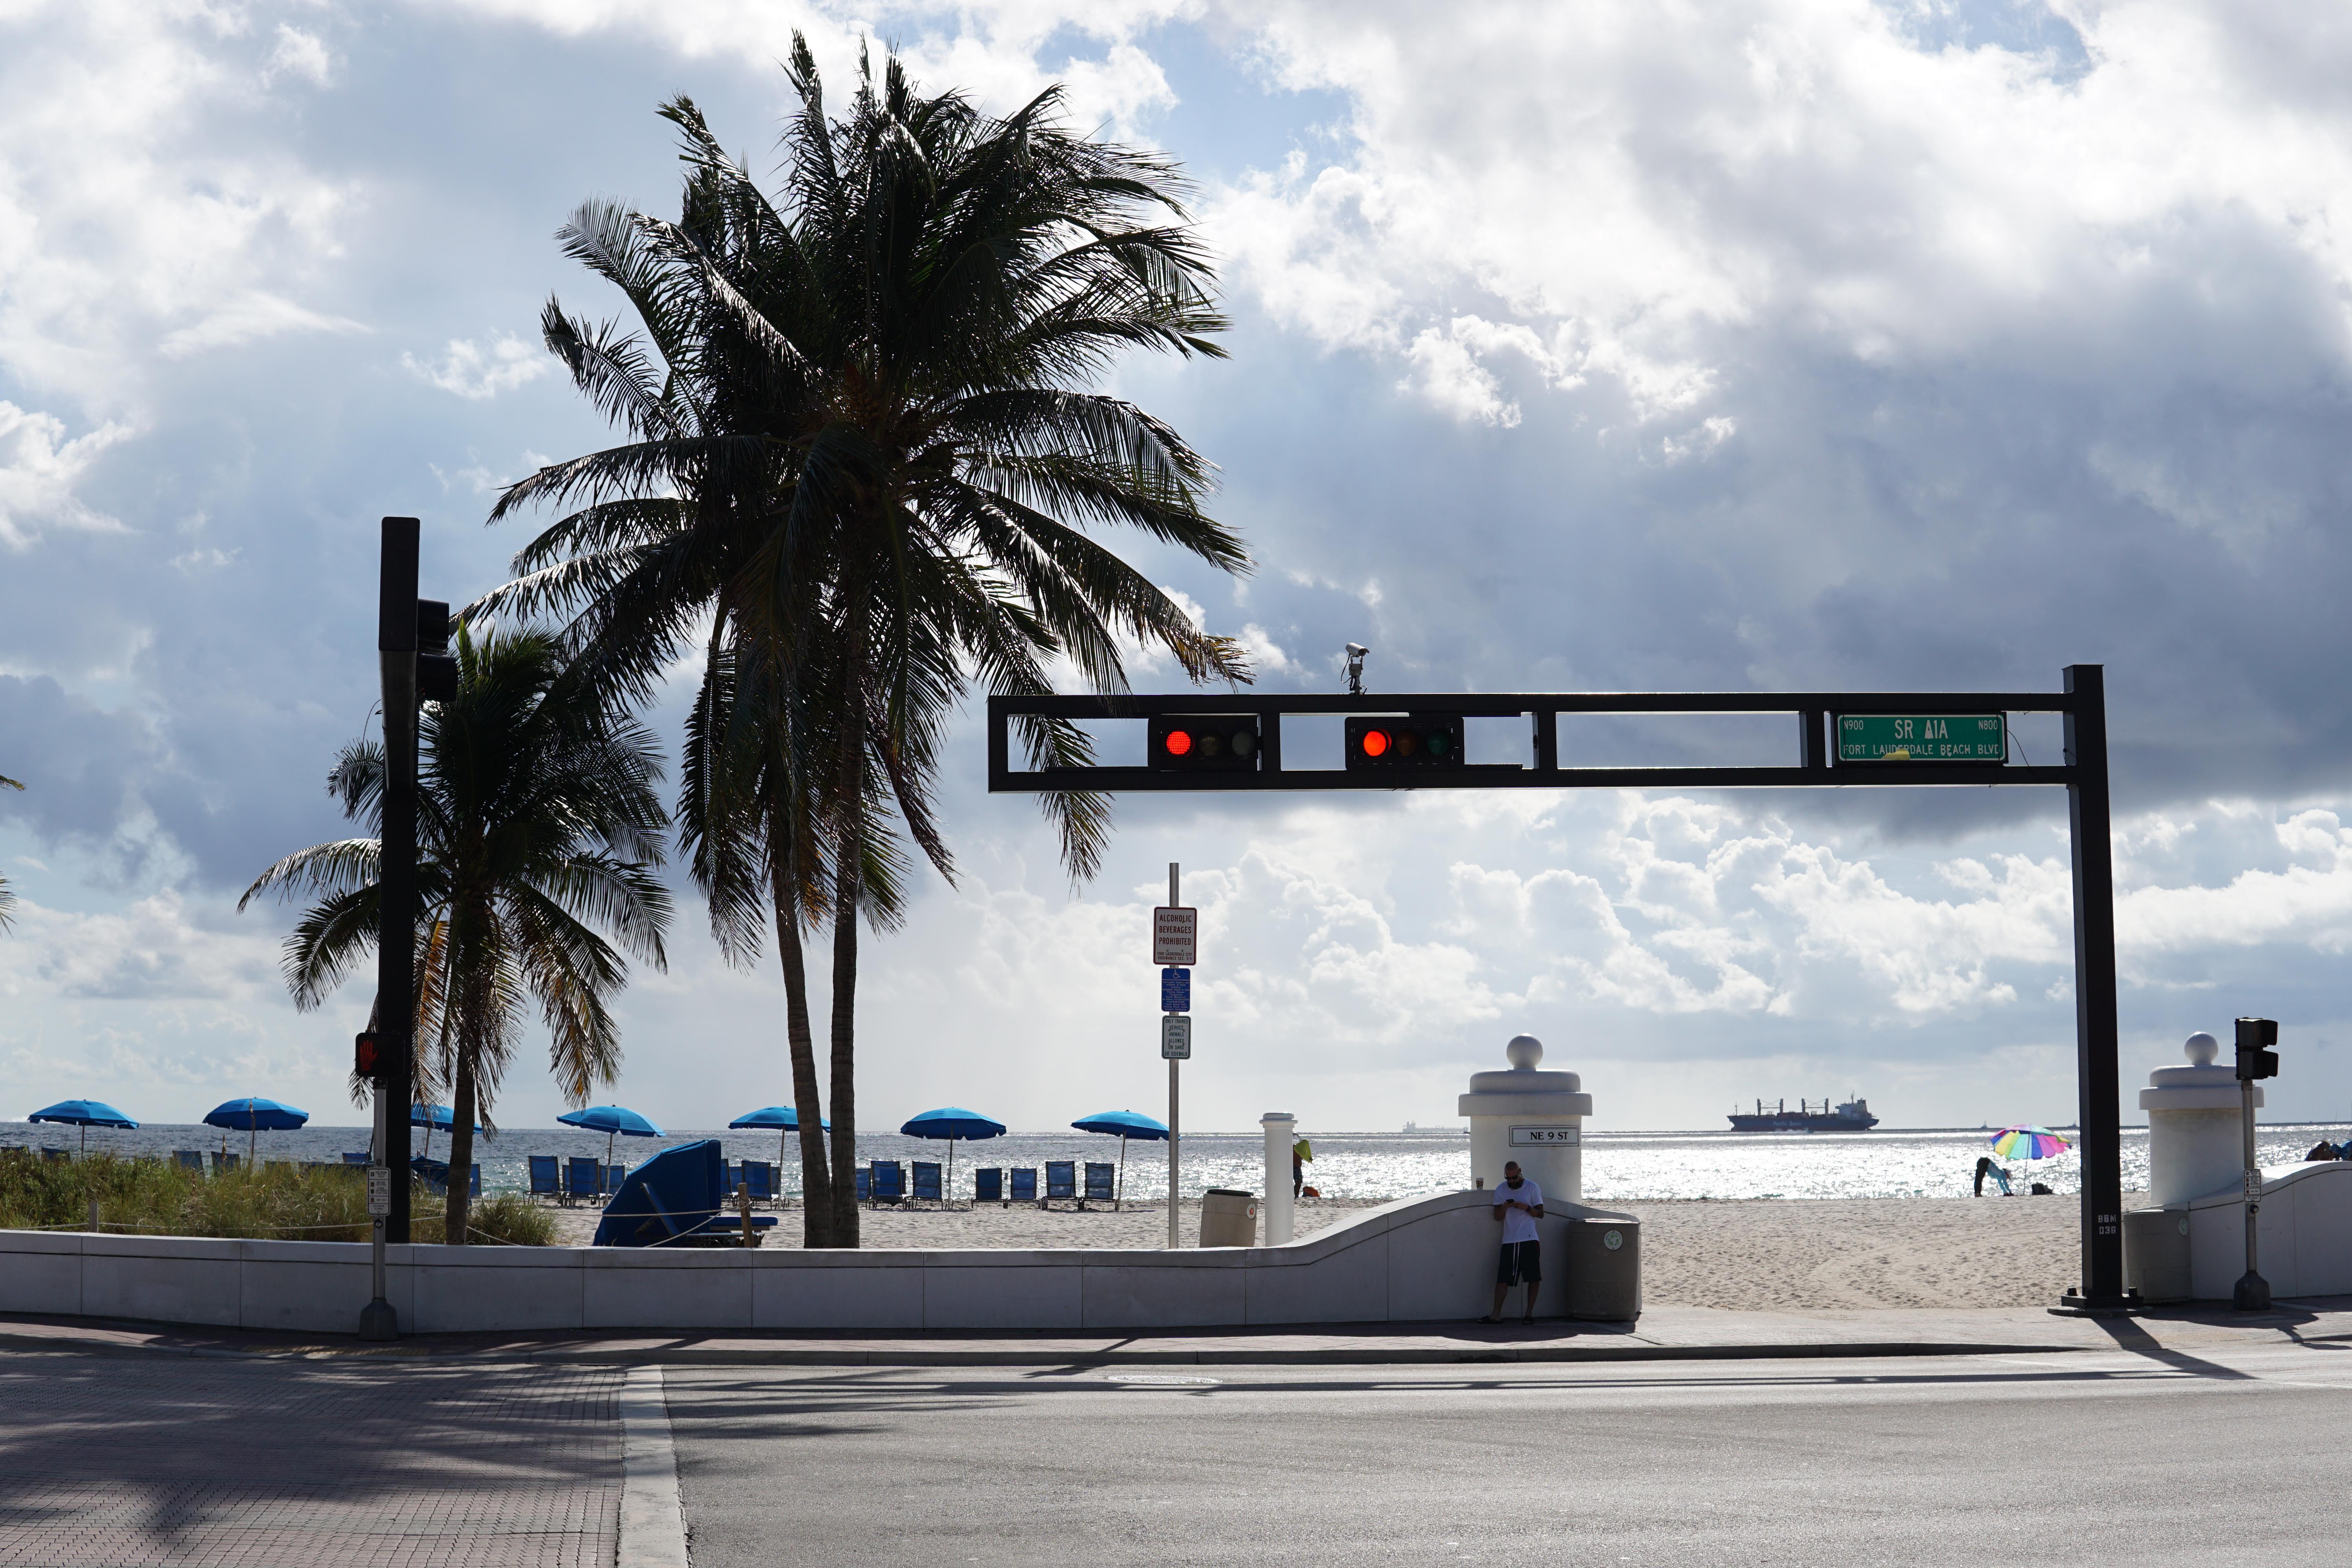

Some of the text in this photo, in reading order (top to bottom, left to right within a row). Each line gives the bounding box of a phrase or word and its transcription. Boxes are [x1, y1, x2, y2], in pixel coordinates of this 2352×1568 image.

[1844, 720, 1864, 730] N900
[1895, 719, 1948, 739] SR A1A
[1978, 720, 1998, 730] N800
[1844, 744, 1866, 755] FORT
[1941, 744, 1970, 756] BEACH
[1978, 744, 1999, 754] BLVD
[1159, 914, 1192, 922] ALCOHOLIC
[1530, 1132, 1544, 1140] NE
[1558, 1132, 1568, 1140] ST
